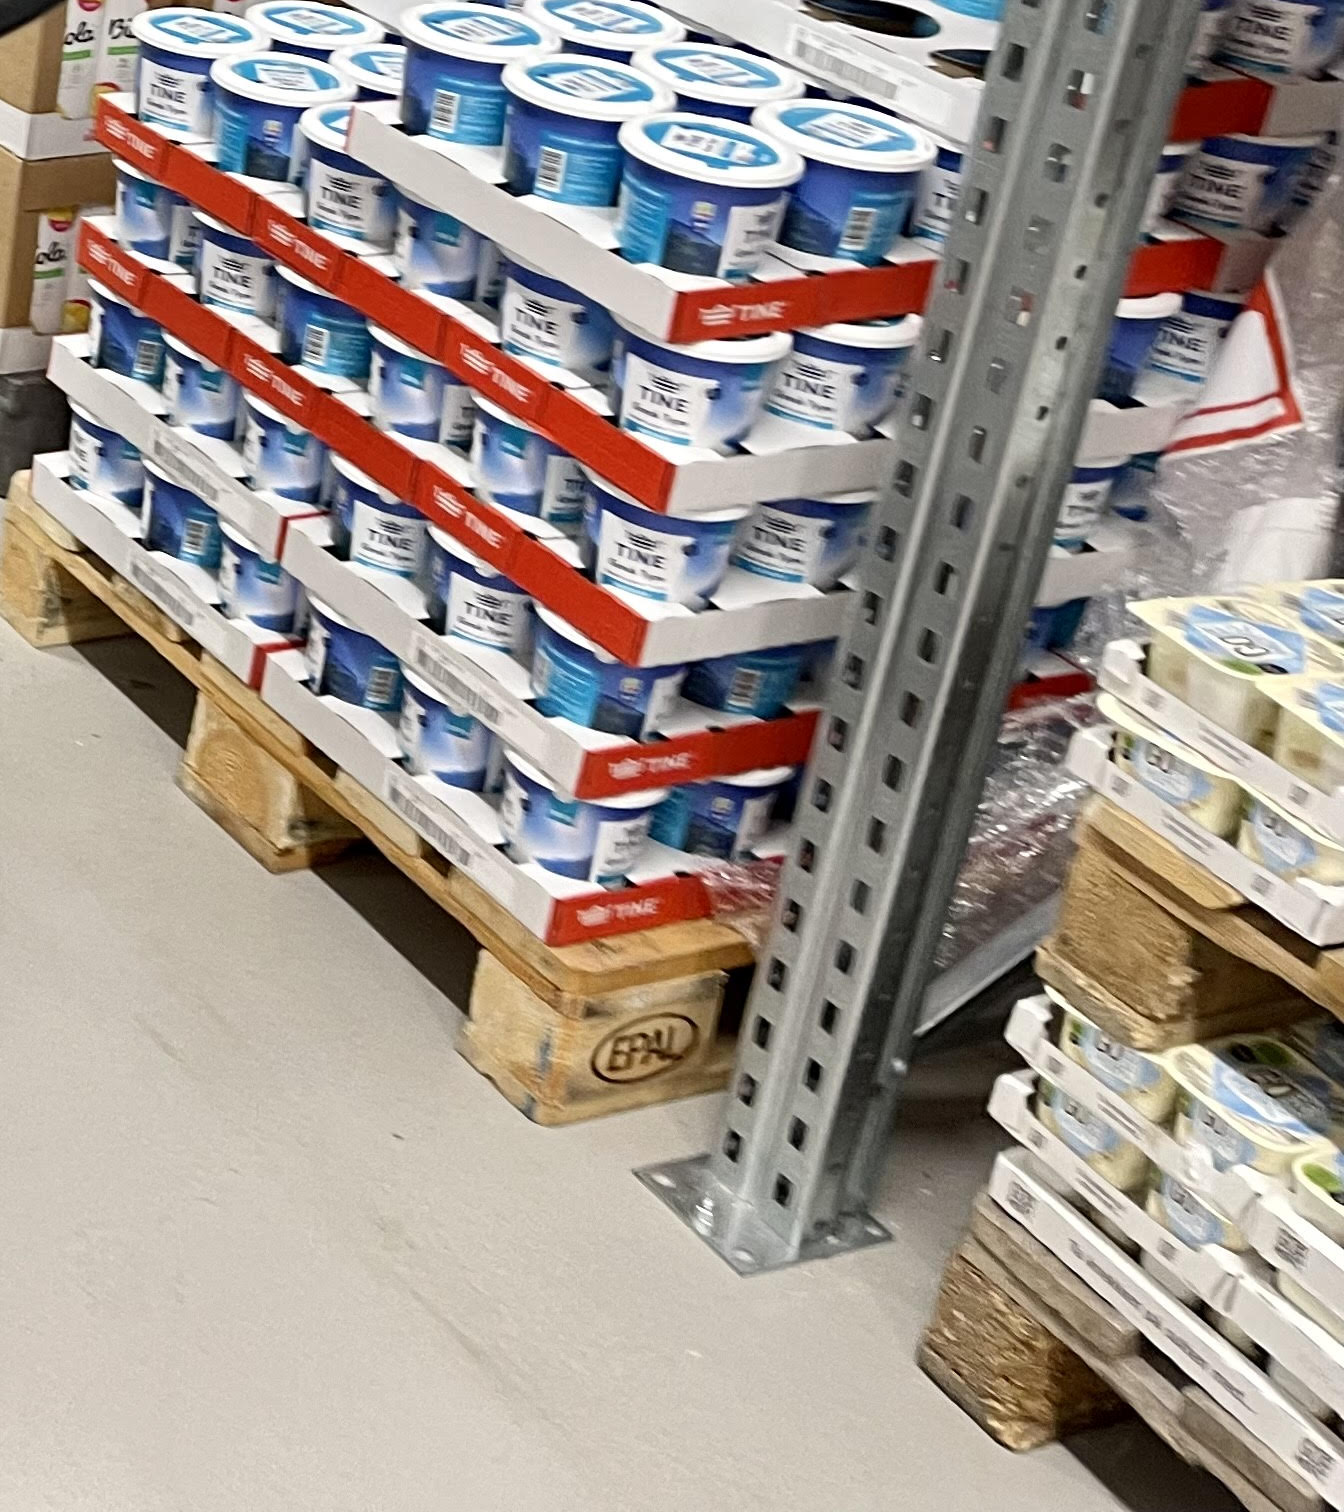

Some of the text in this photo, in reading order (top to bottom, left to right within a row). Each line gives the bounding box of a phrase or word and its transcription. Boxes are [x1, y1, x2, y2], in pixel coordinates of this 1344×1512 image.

[1236, 15, 1294, 41] TINE
[150, 83, 187, 104] TINE
[126, 128, 160, 160] TINE
[320, 186, 362, 211] TINE
[292, 238, 331, 270] TINE
[105, 254, 138, 287] TINE
[212, 265, 253, 289] TINE
[514, 307, 561, 337] TINE
[731, 300, 789, 322] TINE
[270, 373, 305, 408] TINE
[491, 366, 531, 404] TINE
[639, 384, 689, 413] TINE
[782, 371, 837, 399] TINE
[368, 527, 414, 551] TINE
[464, 510, 505, 550] TINE
[752, 525, 808, 553] TINE
[616, 541, 666, 569] TINE
[464, 600, 513, 626] TINE
[642, 752, 692, 774] TINE
[614, 897, 661, 921] TINE
[606, 1024, 685, 1073] EPAL
